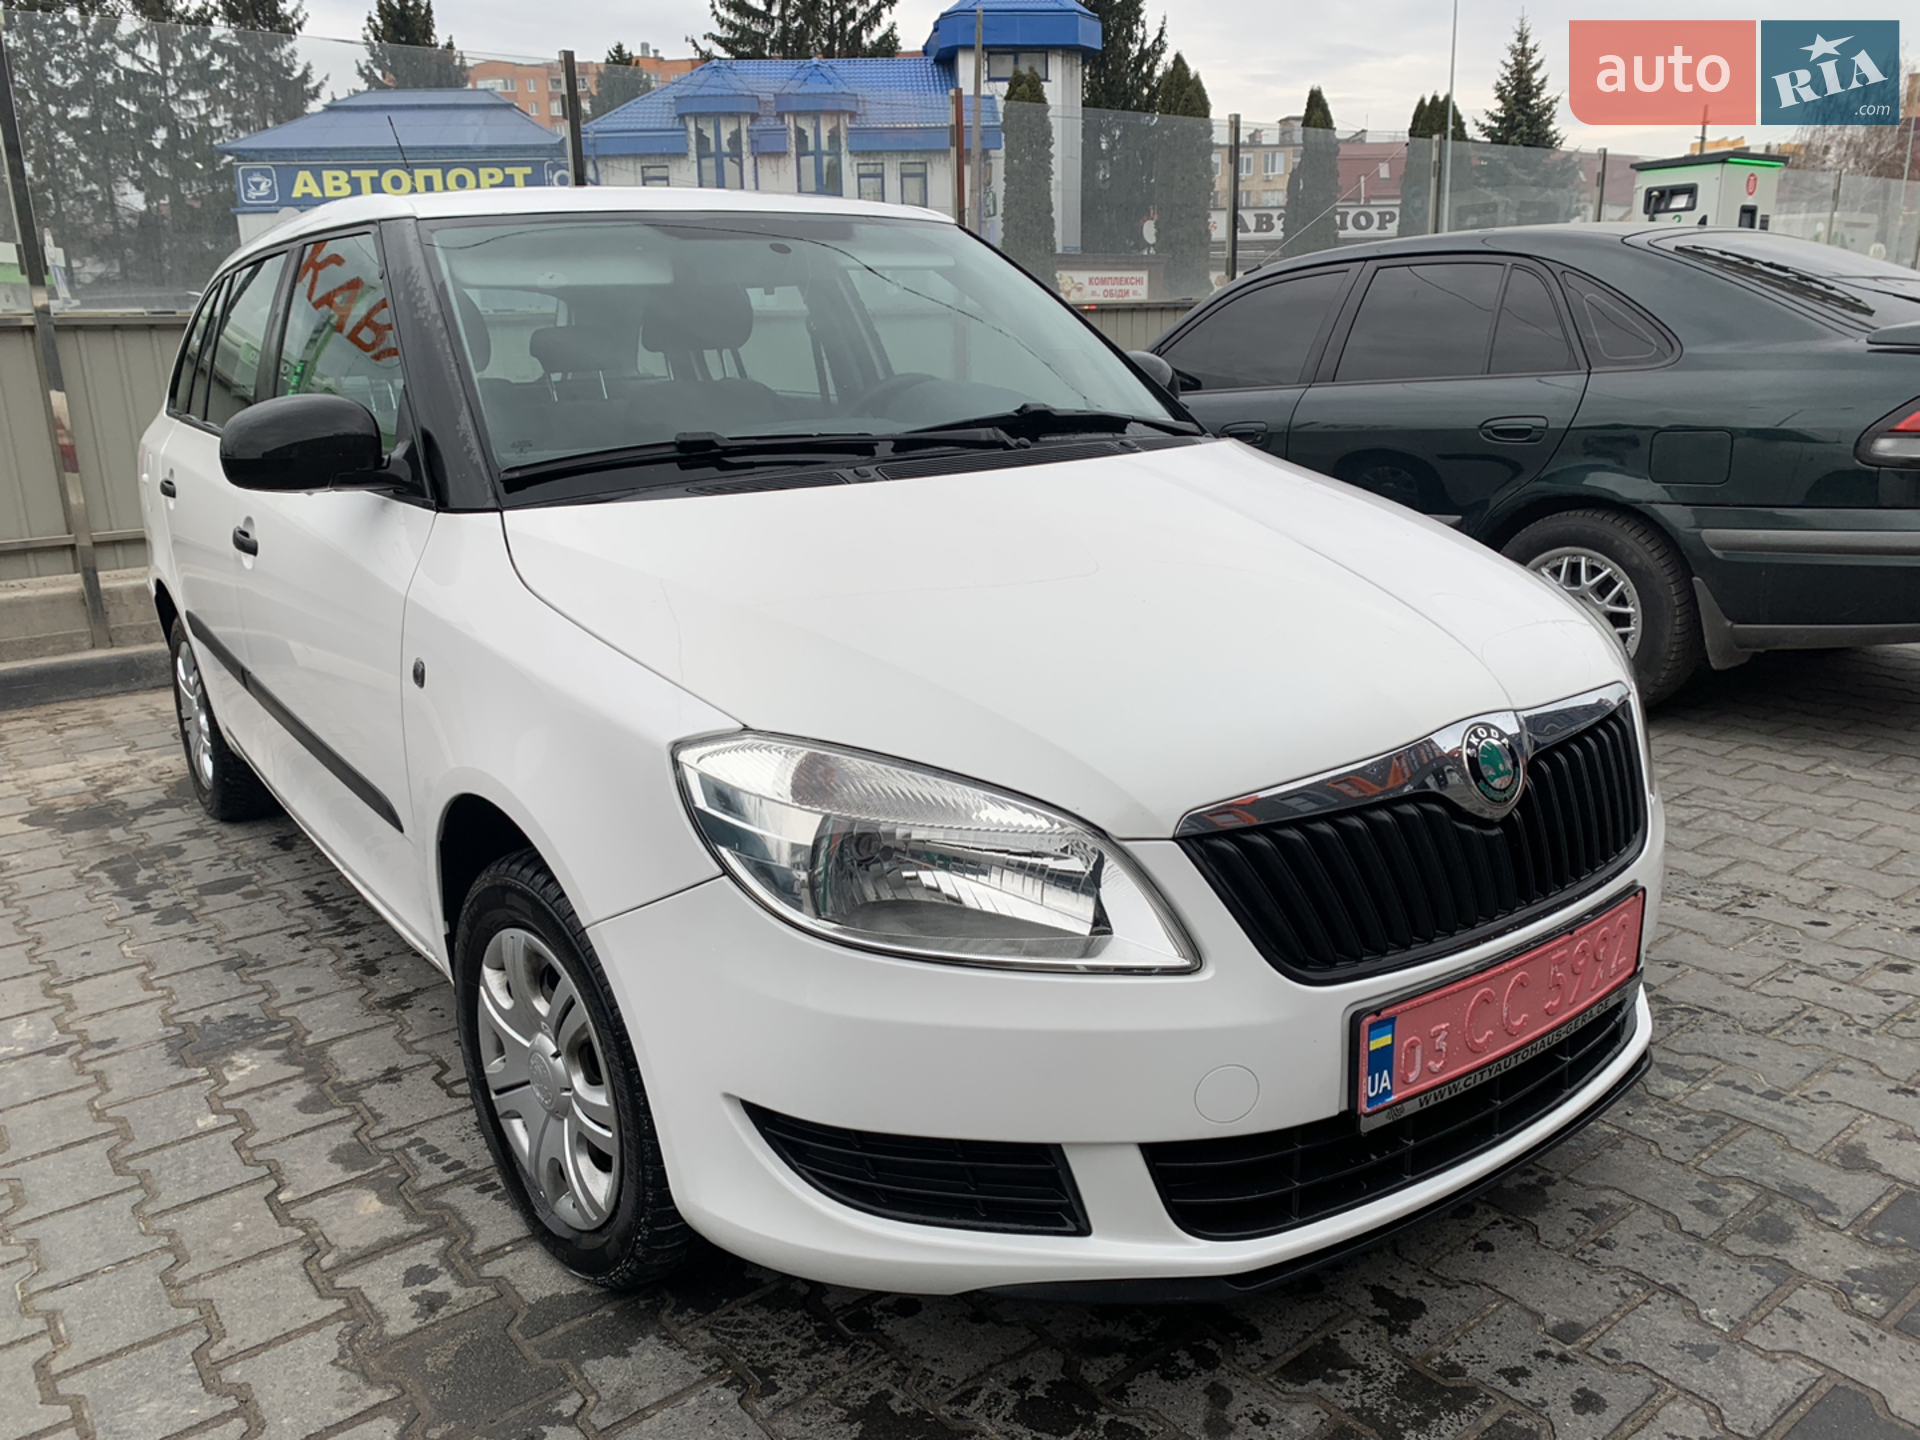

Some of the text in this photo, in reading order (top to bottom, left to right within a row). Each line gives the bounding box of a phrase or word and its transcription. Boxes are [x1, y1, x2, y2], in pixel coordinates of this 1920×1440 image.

[291, 166, 532, 198] АВТОПОРТ
[1088, 276, 1144, 286] КОМПЛЕКСНІ
[1102, 289, 1130, 299] ОБІДИ
[1543, 913, 1631, 1016] 5992
[1418, 999, 1611, 1108] WWW.CITYAUTOHAUS-GERA.DE
[1367, 1069, 1391, 1098] UA
